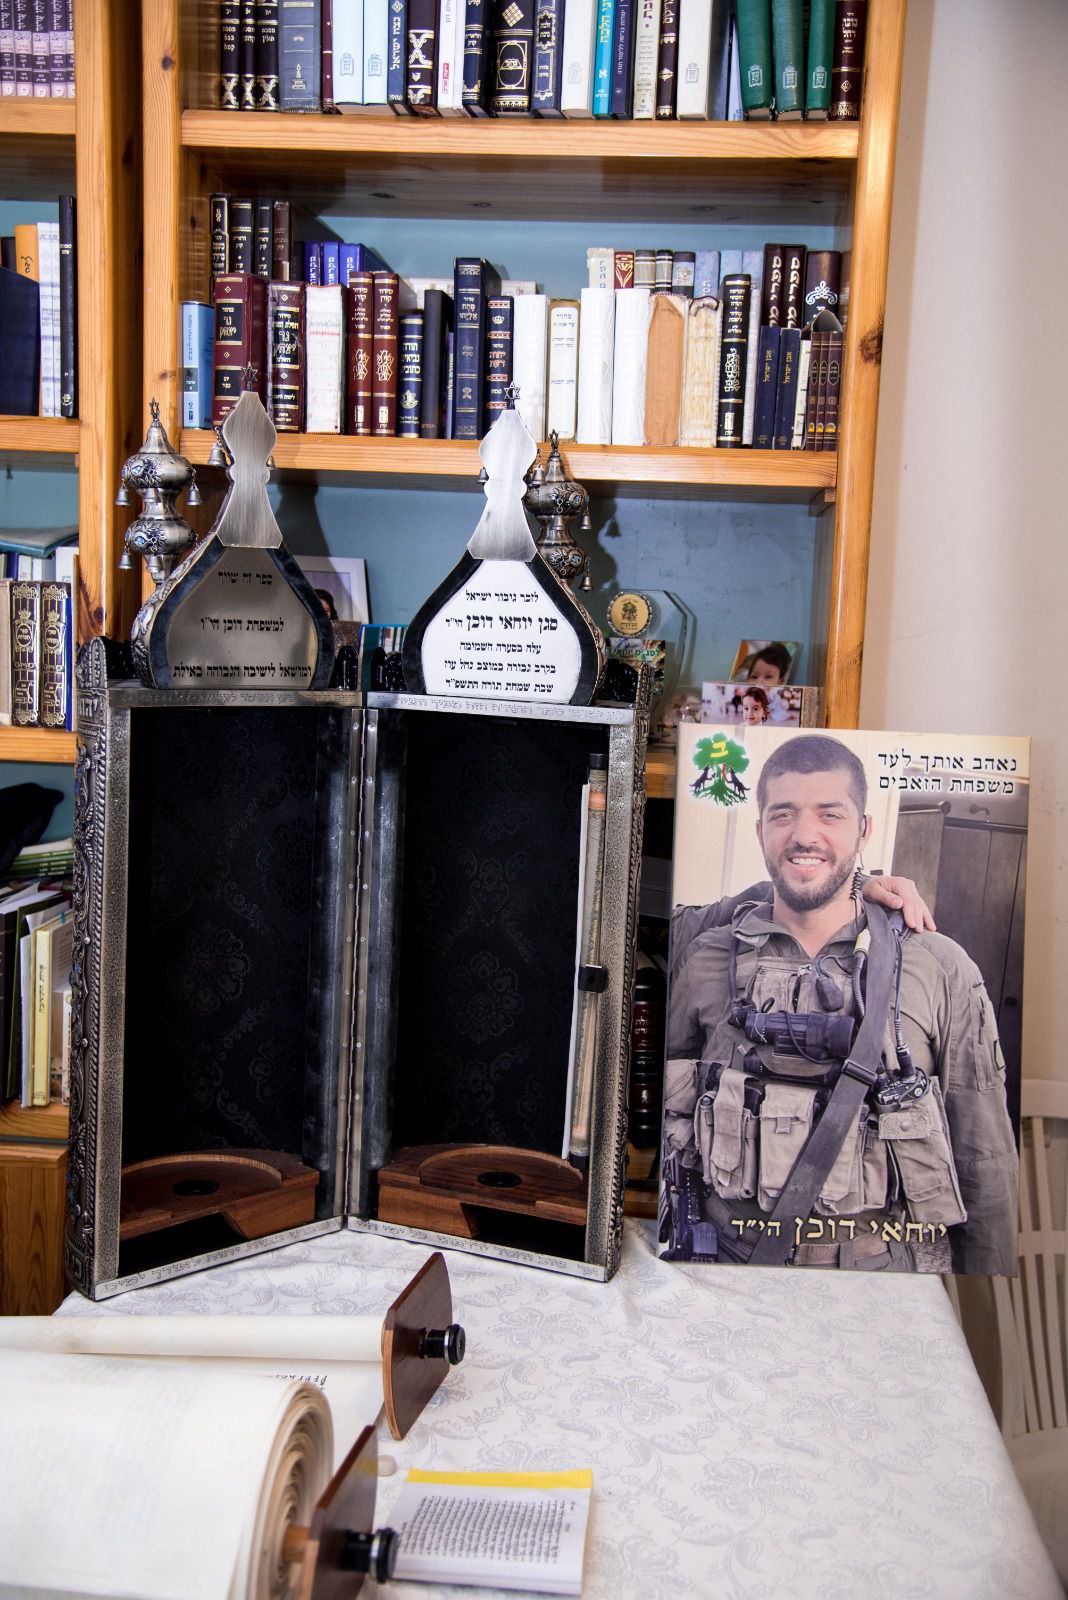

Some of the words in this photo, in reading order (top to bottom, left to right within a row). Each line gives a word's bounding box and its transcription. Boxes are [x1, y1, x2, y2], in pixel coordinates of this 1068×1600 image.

[599, 15, 610, 43] הלכה
[390, 38, 400, 70] ישראל
[598, 69, 608, 79] א
[770, 255, 782, 300] ספרי
[790, 257, 800, 302] ספרי
[459, 311, 478, 320] אליהו
[402, 342, 418, 351] תורה
[782, 364, 791, 384] ישראל
[242, 572, 252, 583] זה
[256, 574, 272, 585] ספר
[466, 590, 492, 602] ישראל
[495, 592, 517, 602] גיבור
[520, 591, 538, 602] לזכר
[223, 619, 242, 633] דוכן
[246, 618, 284, 632] למשפחת
[446, 618, 463, 628] הי"ד
[466, 614, 493, 632] דוכן
[499, 616, 533, 631] יוחאי
[538, 617, 558, 634] סגן
[460, 642, 493, 652] השמימה
[496, 642, 522, 653] בסערה
[526, 642, 542, 654] עלה
[173, 662, 203, 678] באילת
[243, 662, 276, 678] לישיבה
[444, 660, 456, 670] עוז
[459, 658, 473, 670] נחל
[476, 662, 503, 672] במוצב
[506, 664, 531, 673] גבורה
[534, 664, 556, 676] בקרב
[207, 664, 240, 677] הגבוהה
[446, 678, 479, 689] התשפ"ד
[481, 680, 502, 690] תורה
[505, 682, 530, 692] שמחת
[534, 683, 554, 693] שבת
[878, 748, 913, 768] לעד
[921, 753, 964, 771] אותך
[972, 754, 1017, 772] נאהב
[879, 776, 941, 792] הזאבים
[949, 779, 1014, 794] משפחת
[730, 1219, 782, 1238] הי"ד
[794, 1217, 856, 1245] דוכן
[870, 1220, 948, 1244] יוחאי
